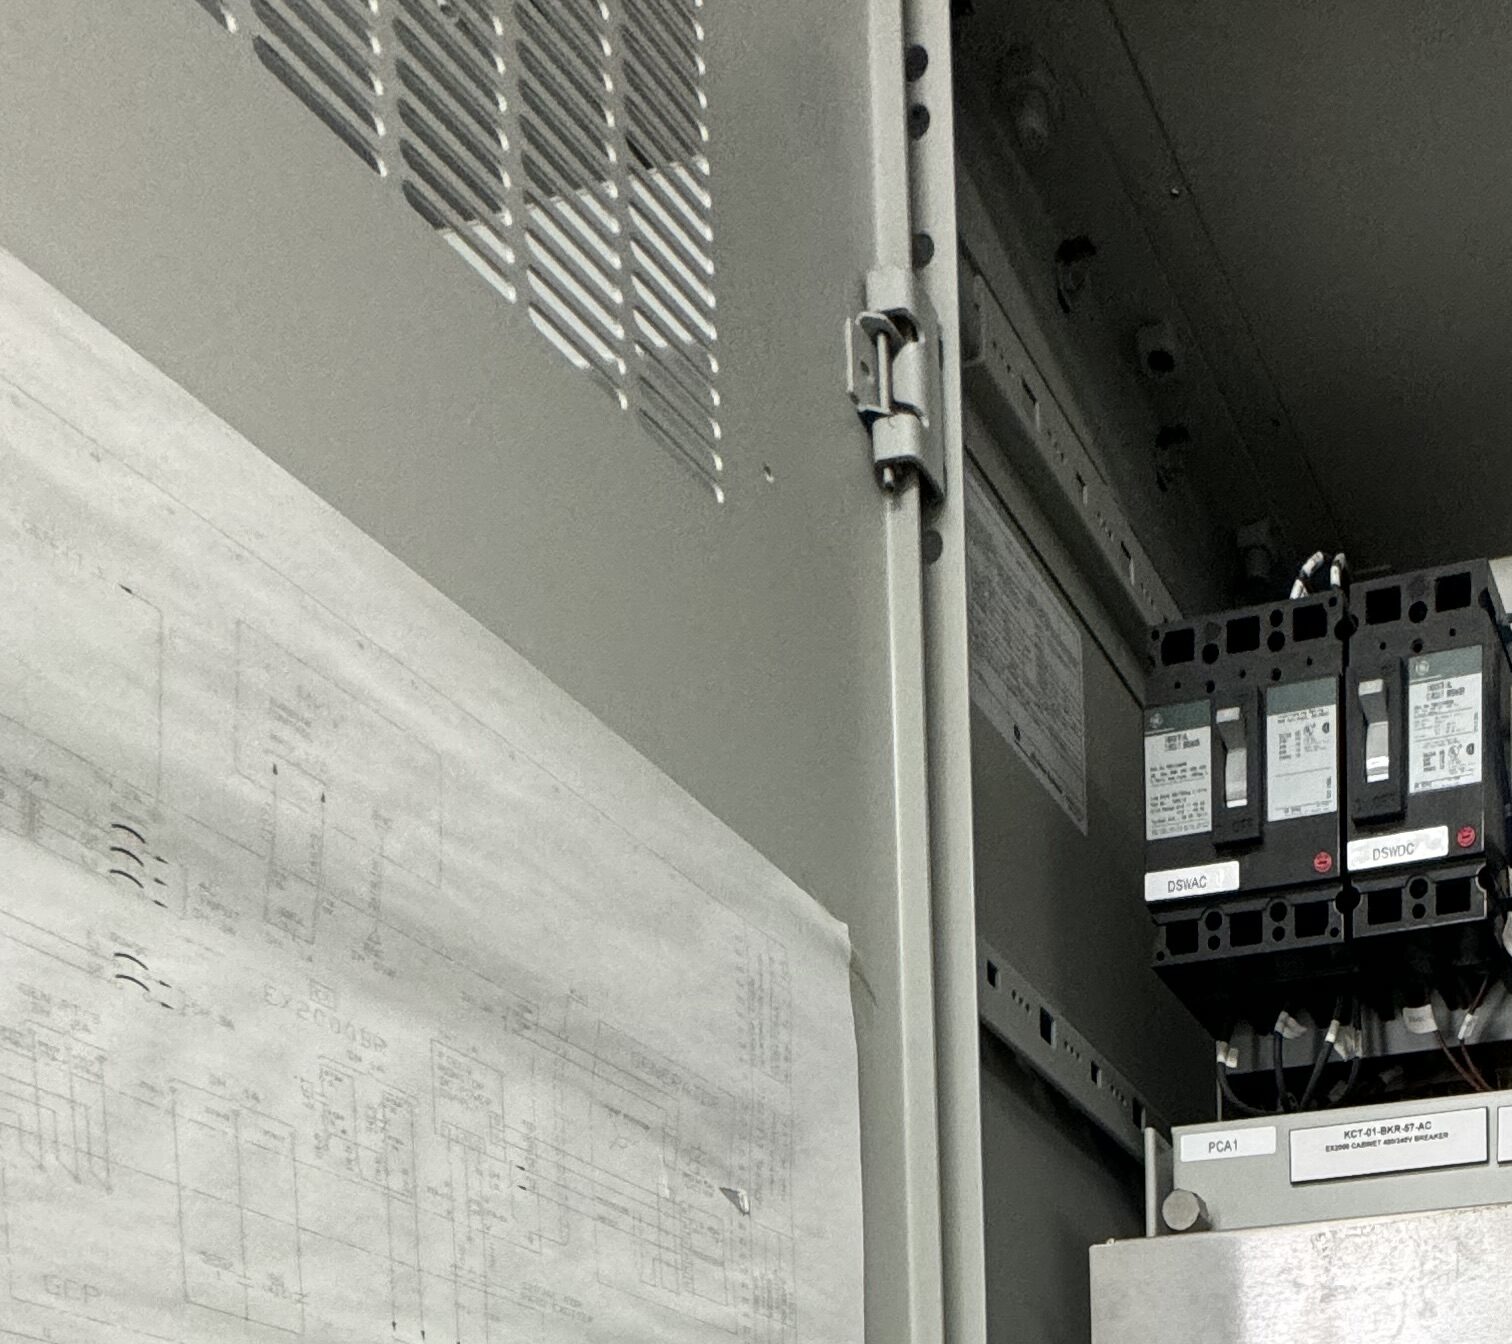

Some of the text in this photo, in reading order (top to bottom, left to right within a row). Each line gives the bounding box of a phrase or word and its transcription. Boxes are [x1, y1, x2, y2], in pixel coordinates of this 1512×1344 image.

[1372, 842, 1415, 861] DSWDC
[1167, 875, 1208, 893] DSWAC
[1344, 1121, 1432, 1140] KCT-01-BKR-57-AC
[1414, 1132, 1449, 1143] BREAKER
[1208, 1139, 1239, 1154] PCA1
